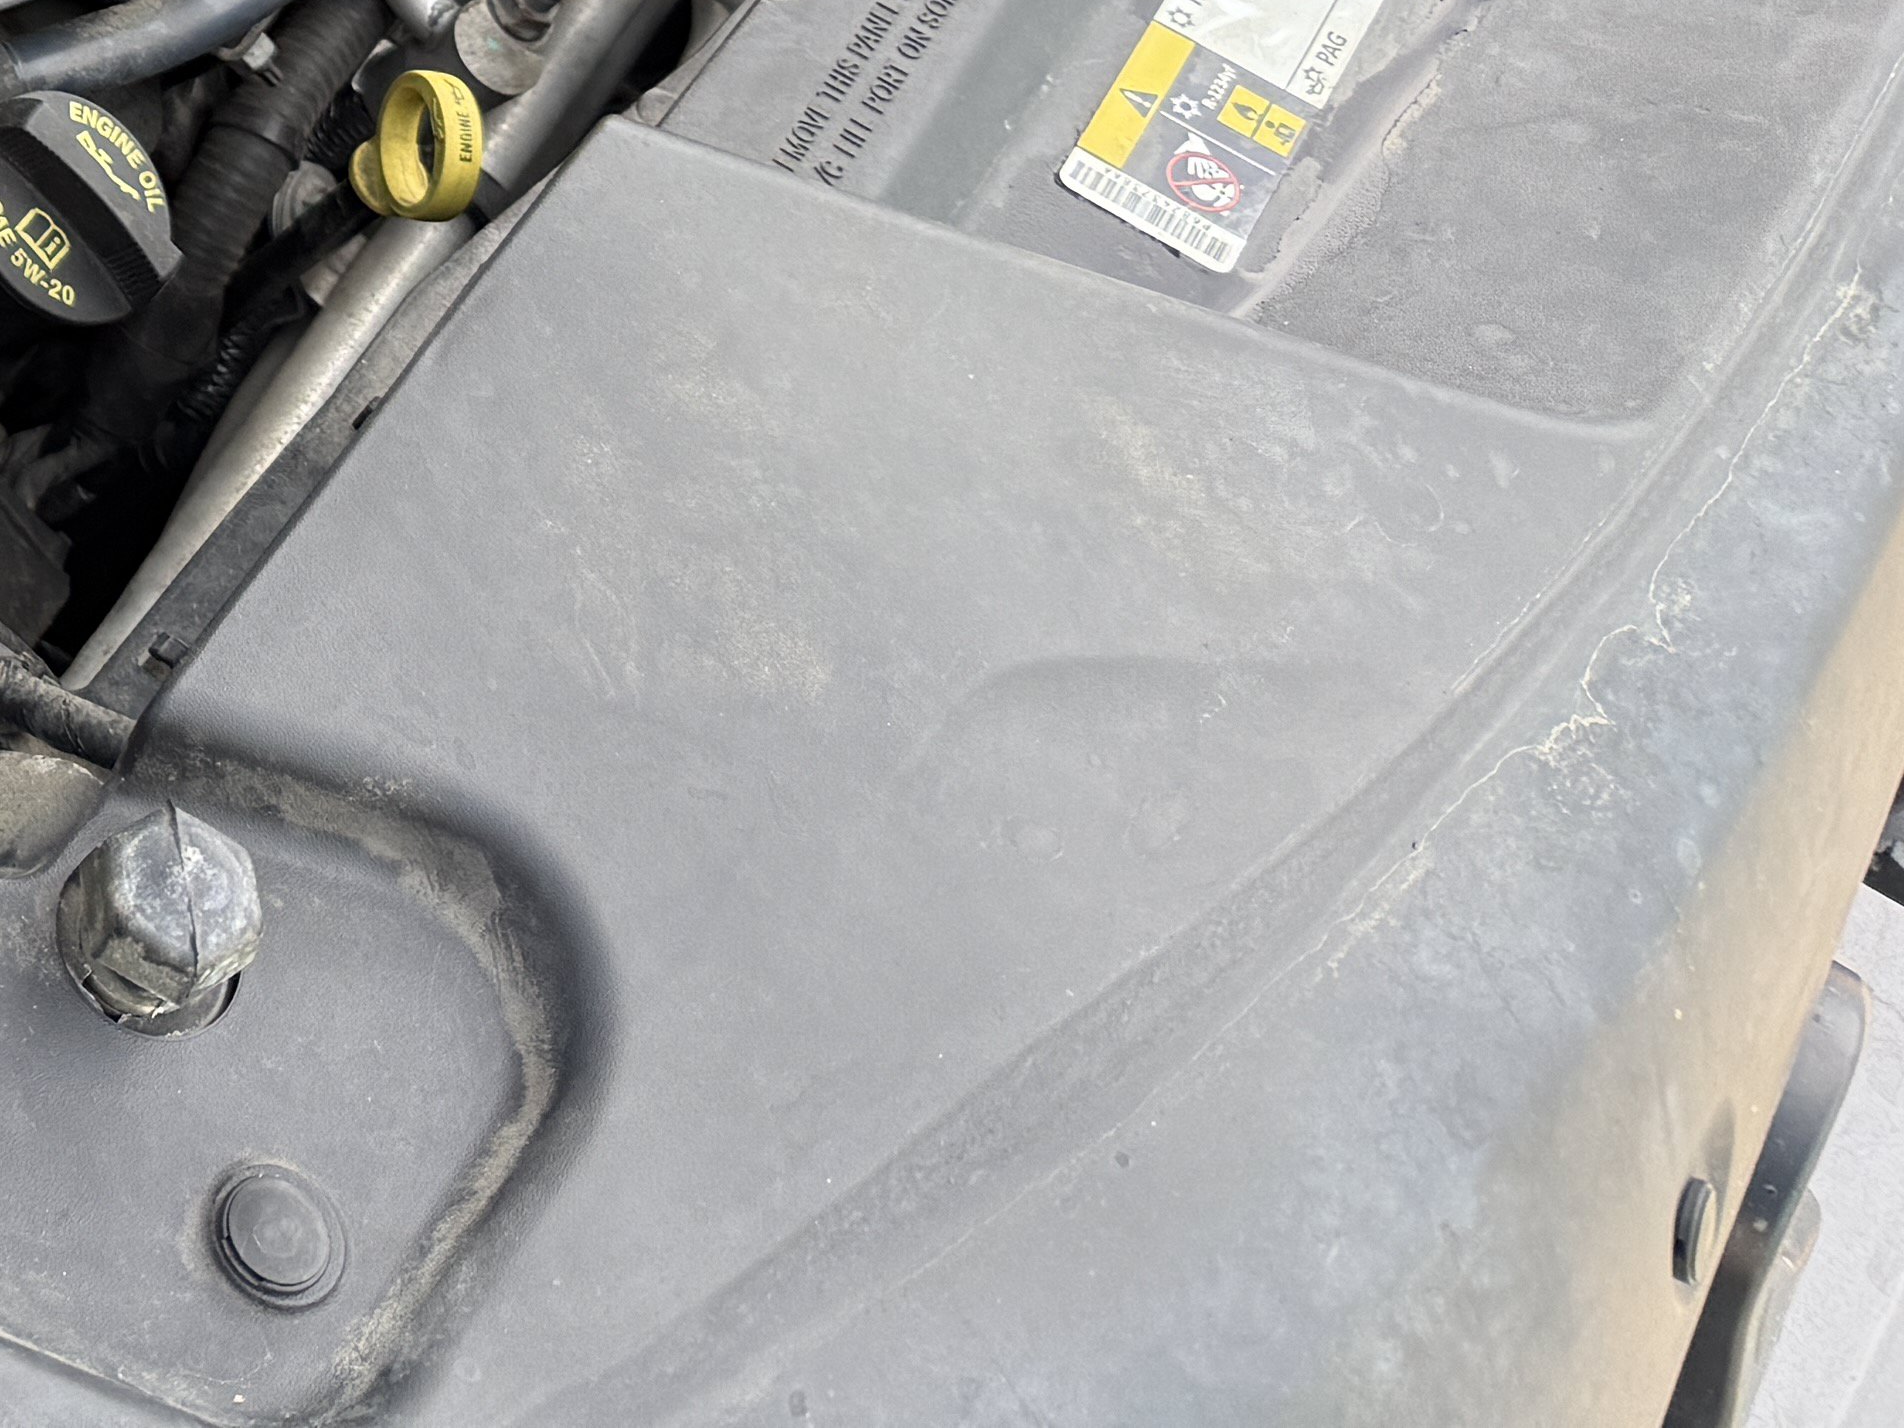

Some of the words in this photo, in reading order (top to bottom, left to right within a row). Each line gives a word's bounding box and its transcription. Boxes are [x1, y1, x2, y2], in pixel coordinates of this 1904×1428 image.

[1316, 32, 1349, 65] PAG
[69, 100, 146, 170] ENGINE
[139, 171, 165, 214] OIL
[772, 105, 830, 173] EMOVE
[11, 248, 76, 307] 5W-20
